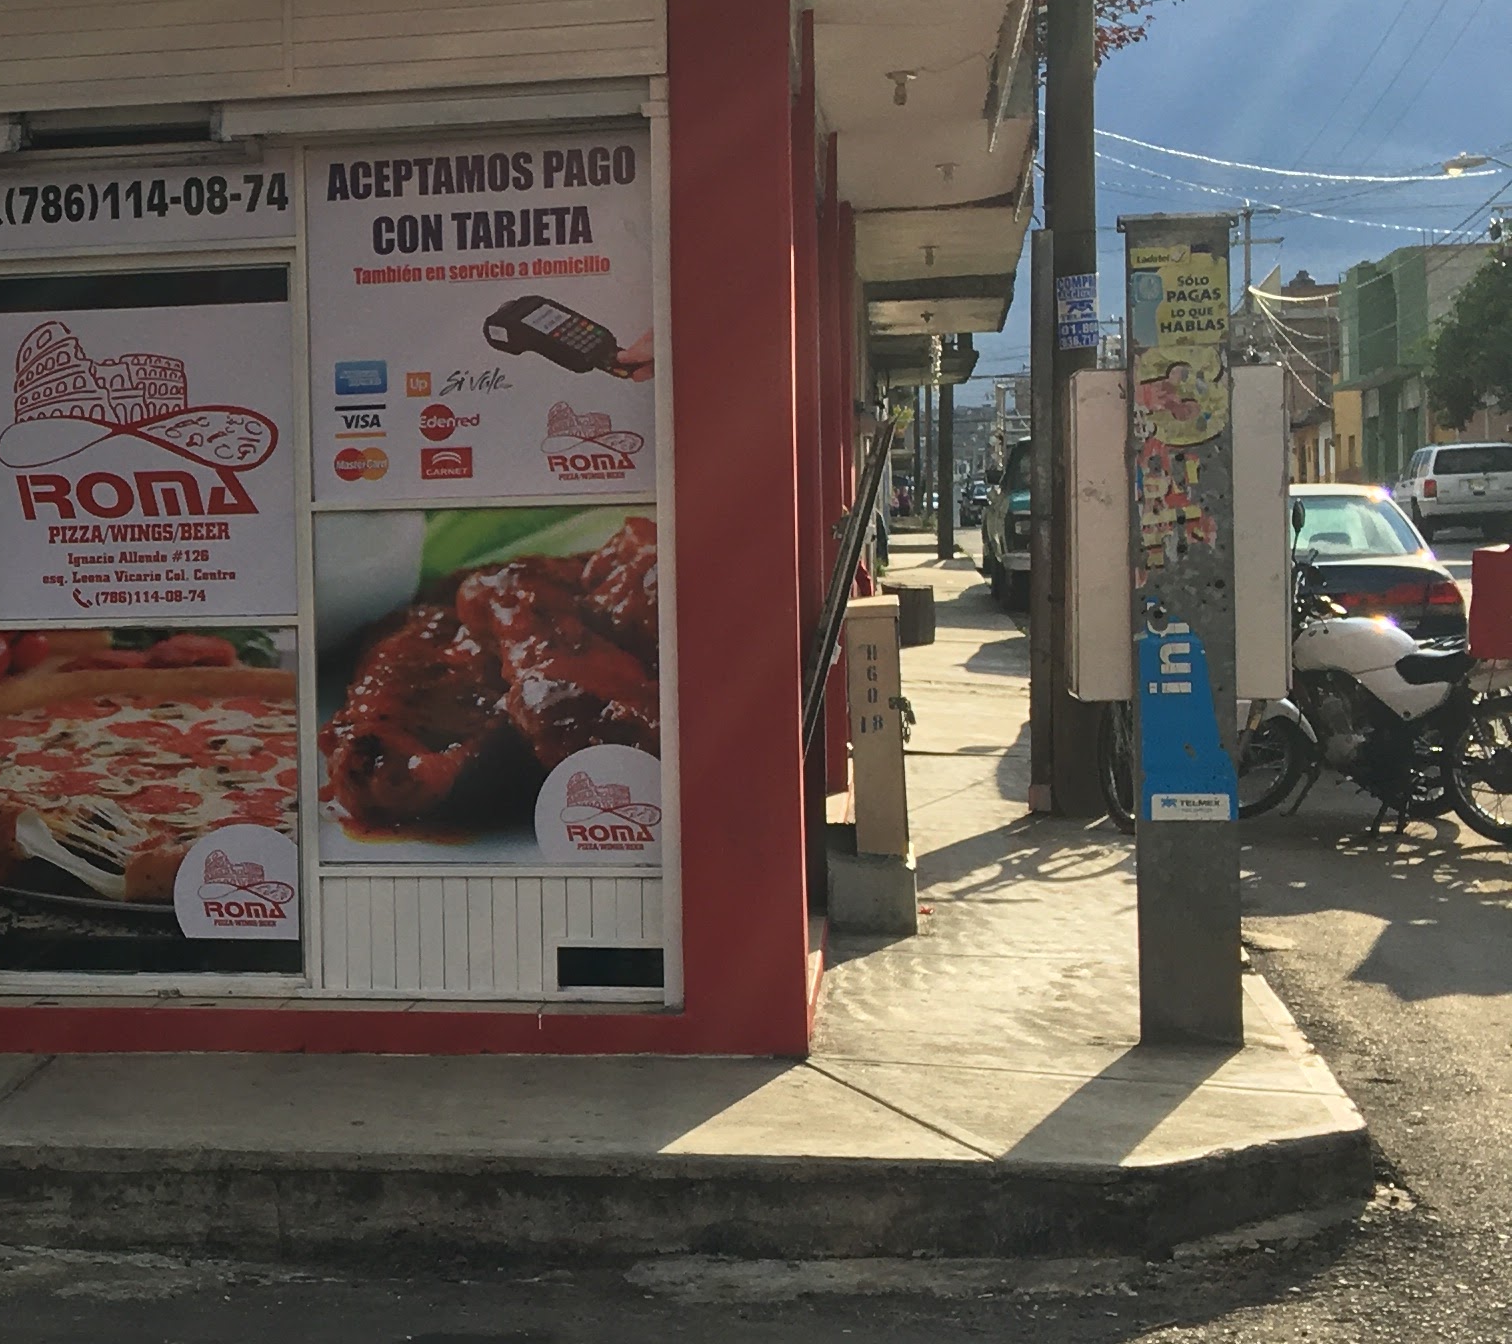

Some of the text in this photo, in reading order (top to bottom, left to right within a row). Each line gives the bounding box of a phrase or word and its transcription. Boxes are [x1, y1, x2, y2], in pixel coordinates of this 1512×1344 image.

[327, 145, 636, 202] ACEPTAMOS PAGO
[5, 173, 288, 226] (786)114-08-74
[372, 206, 593, 255] CON TARJETA
[353, 256, 611, 285] También en servicio a domicilio
[1166, 288, 1221, 303] PAGAS
[1171, 307, 1213, 319] LO QUE
[1160, 318, 1225, 333] HABLAS
[342, 414, 381, 429] VISA
[547, 454, 636, 471] ROMA
[16, 469, 259, 521] ROMA
[48, 522, 230, 545] PIZZA/WINGS/BEER
[68, 552, 114, 568] Ignacio
[114, 570, 161, 582] Vicario
[567, 824, 654, 841] ROMA
[204, 901, 287, 919] ROMA
